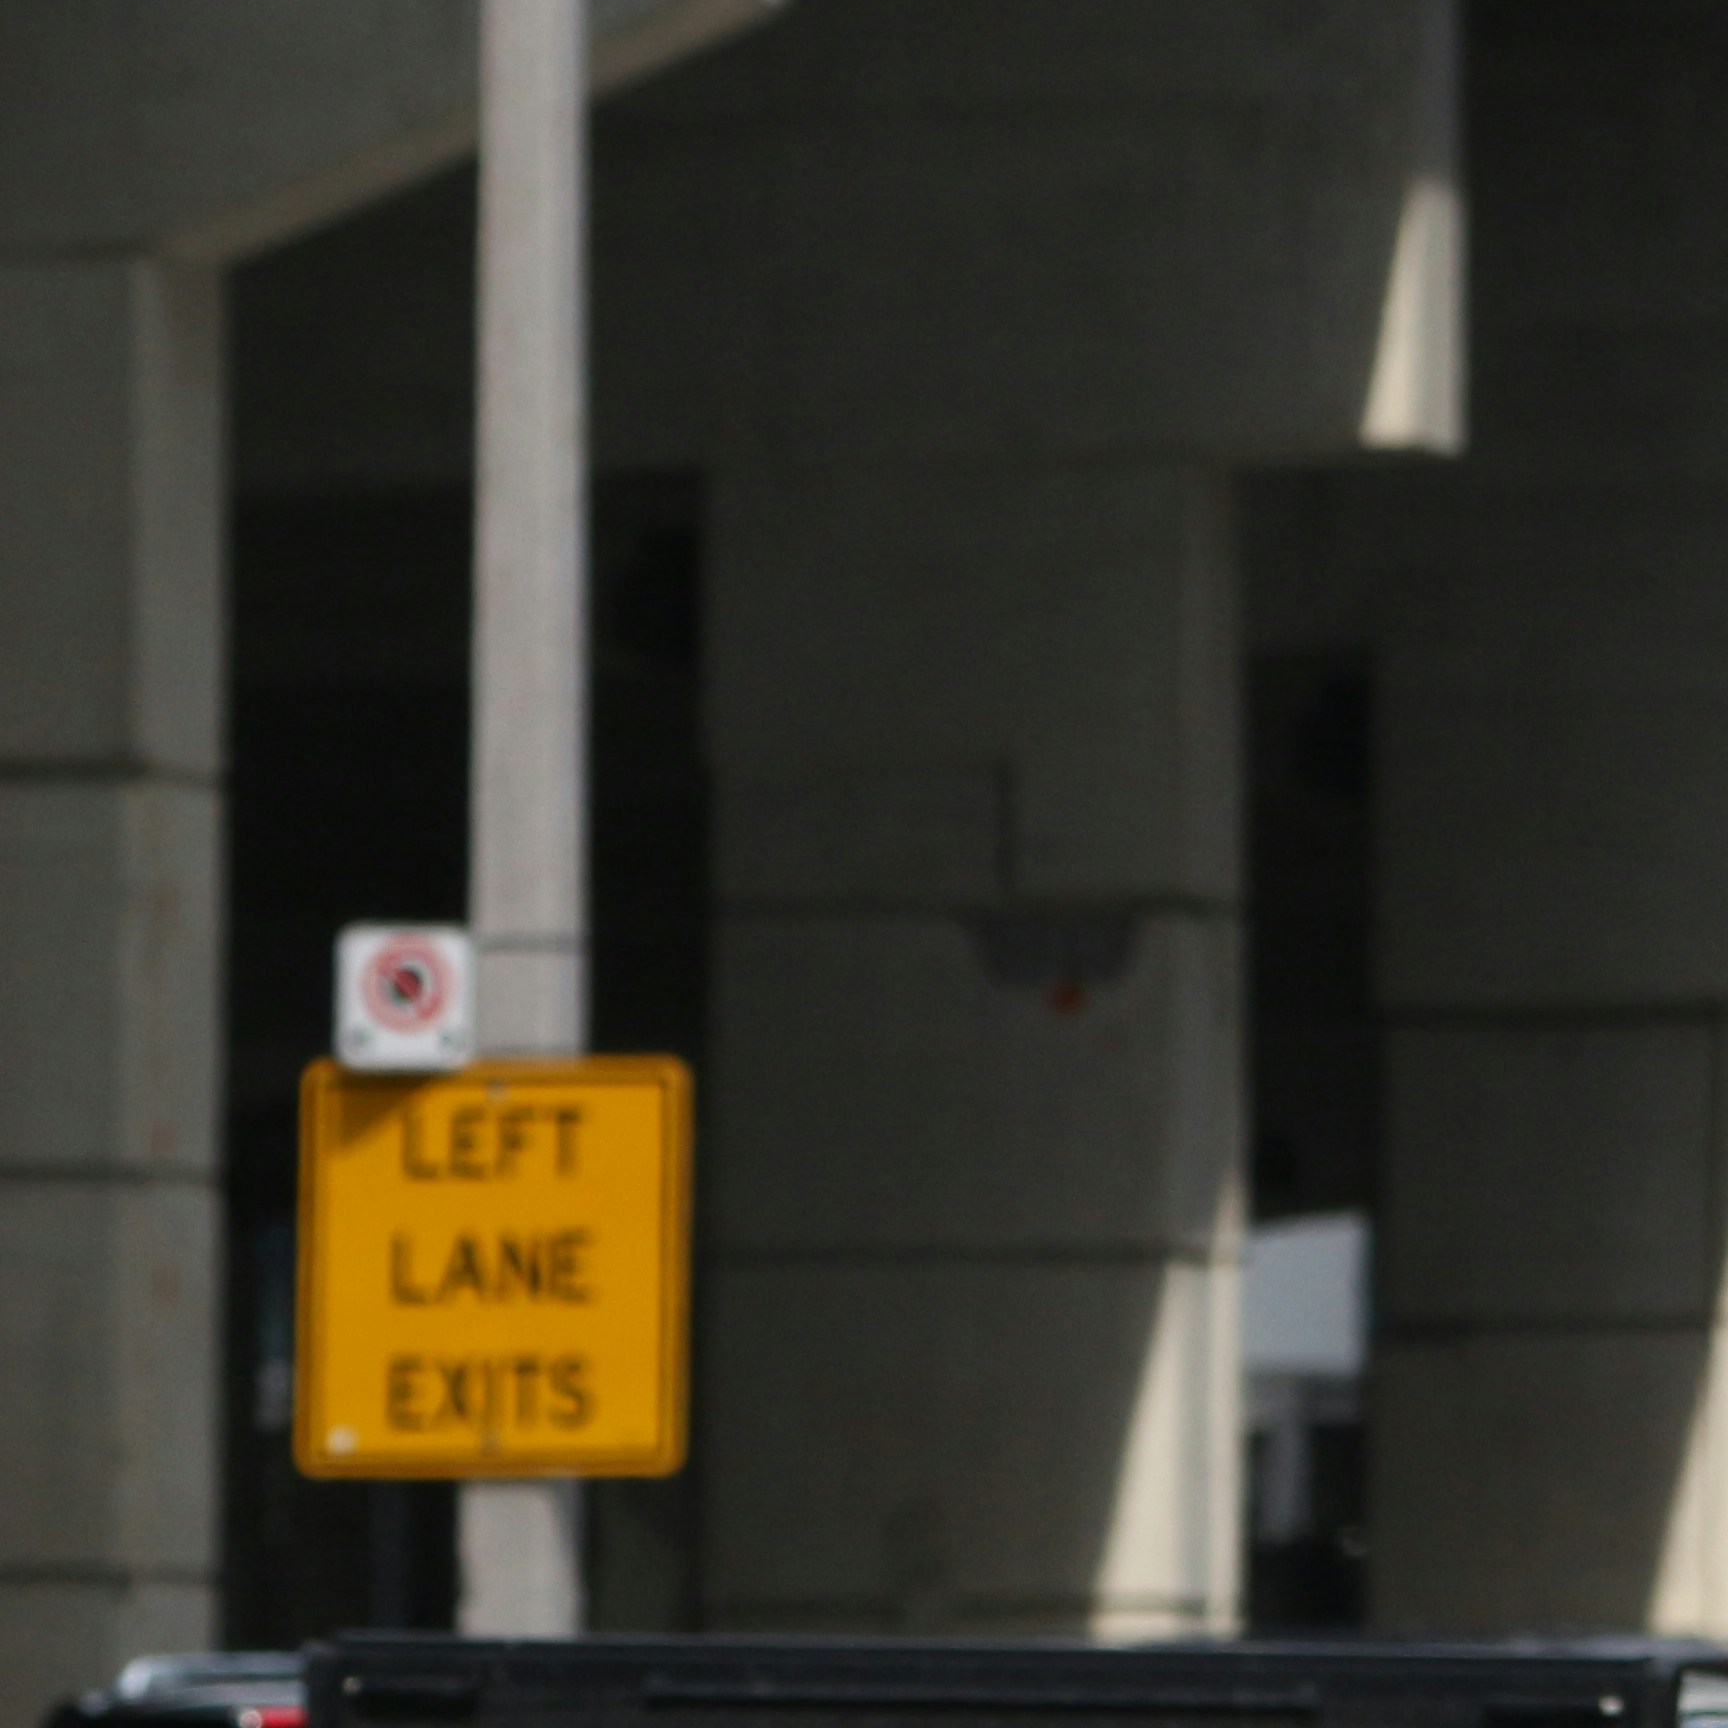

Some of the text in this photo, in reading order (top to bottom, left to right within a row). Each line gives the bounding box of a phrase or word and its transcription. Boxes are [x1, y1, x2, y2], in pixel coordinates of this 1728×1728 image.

[402, 1104, 583, 1181] LEFT
[390, 1228, 594, 1306] LANE
[384, 1354, 596, 1430] EXITS
